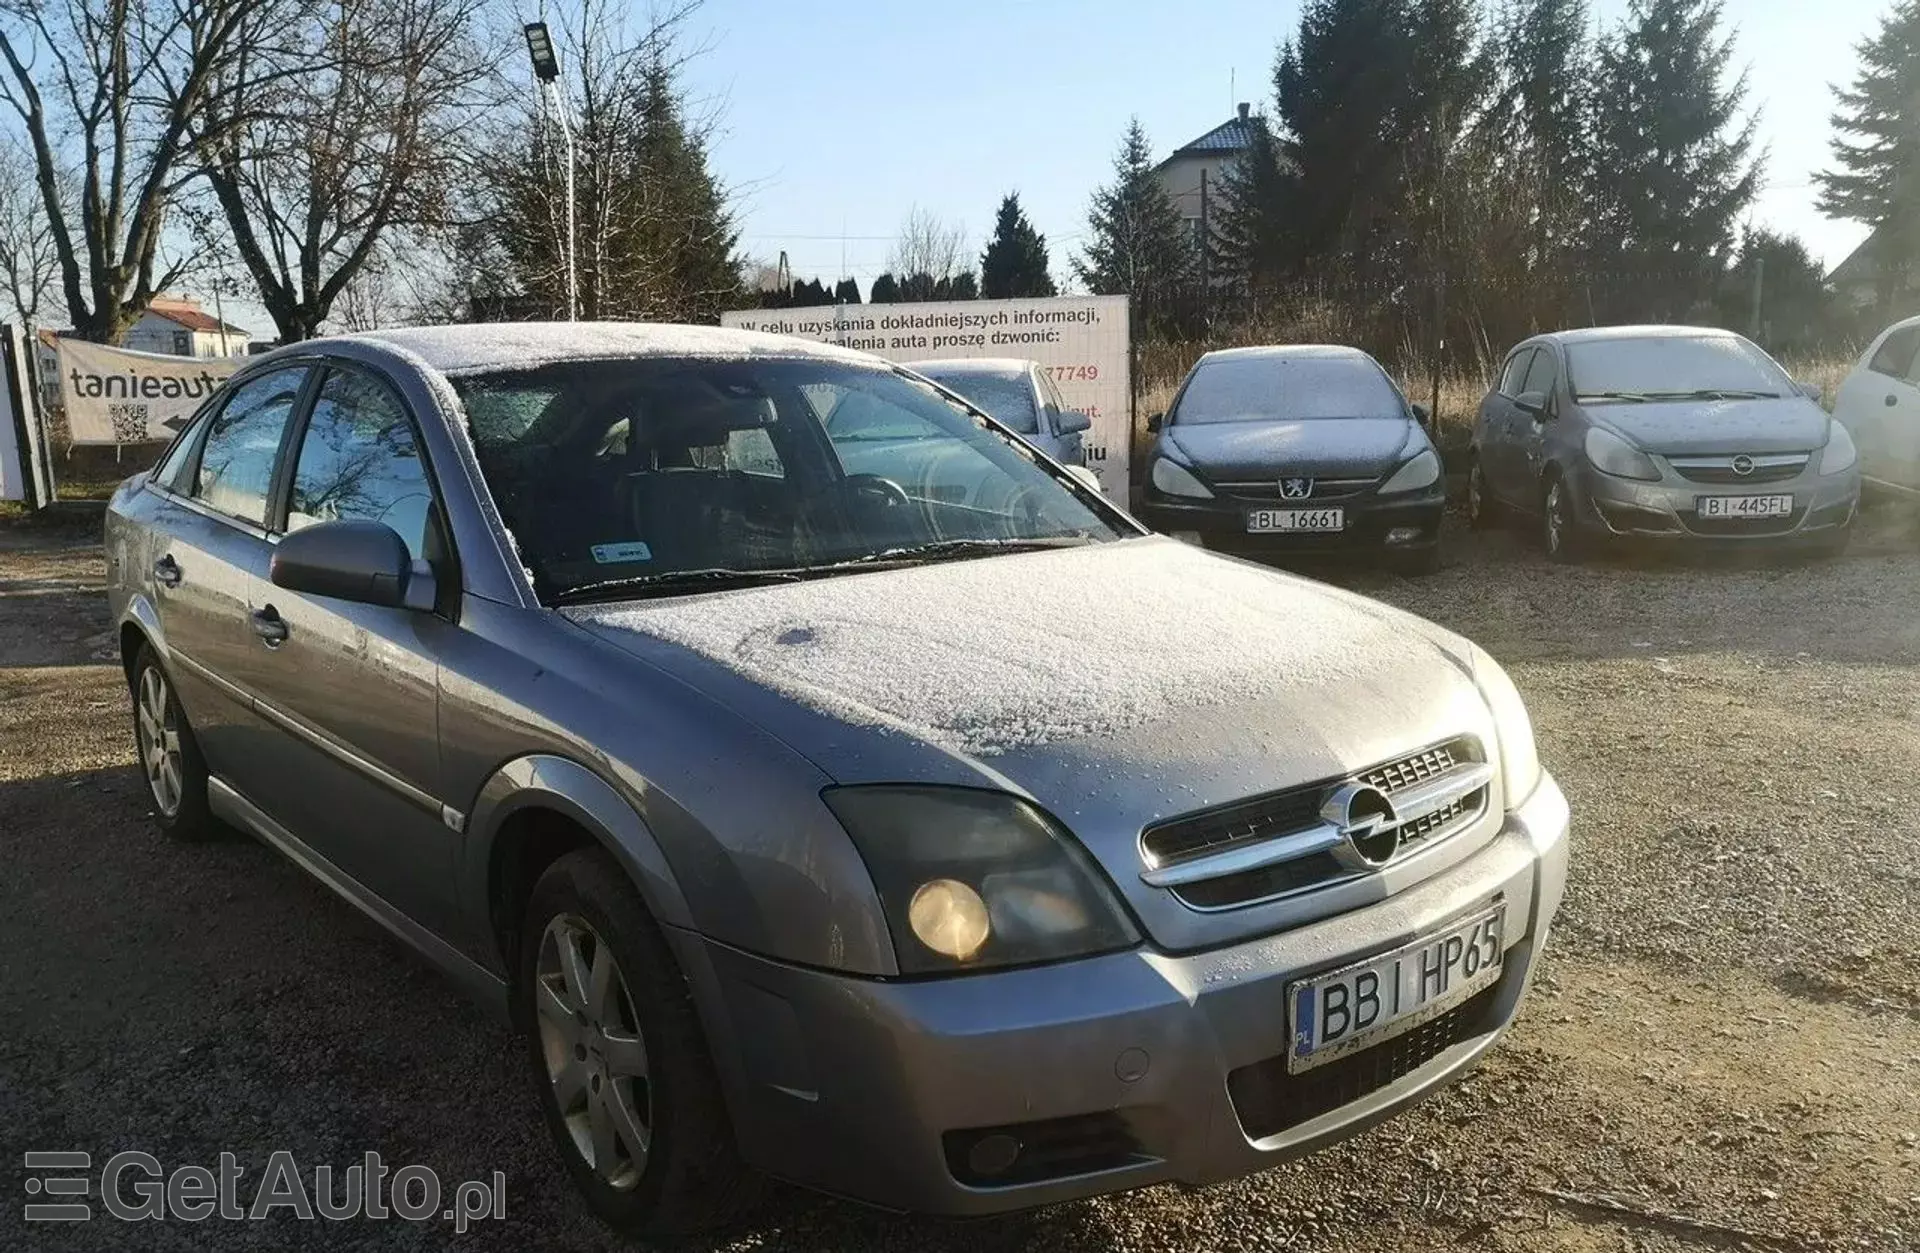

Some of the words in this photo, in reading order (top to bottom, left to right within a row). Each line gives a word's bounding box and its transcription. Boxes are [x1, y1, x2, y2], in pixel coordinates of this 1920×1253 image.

[761, 320, 793, 334] celu
[799, 316, 875, 336] uzyskania
[880, 312, 1008, 330] dokładniejszych
[1014, 308, 1101, 326] informacji,
[891, 334, 927, 348] auta
[932, 333, 985, 350] proszę
[991, 328, 1060, 344] dzwonić:
[70, 368, 228, 399] tanieaut
[1289, 511, 1338, 528] 16661
